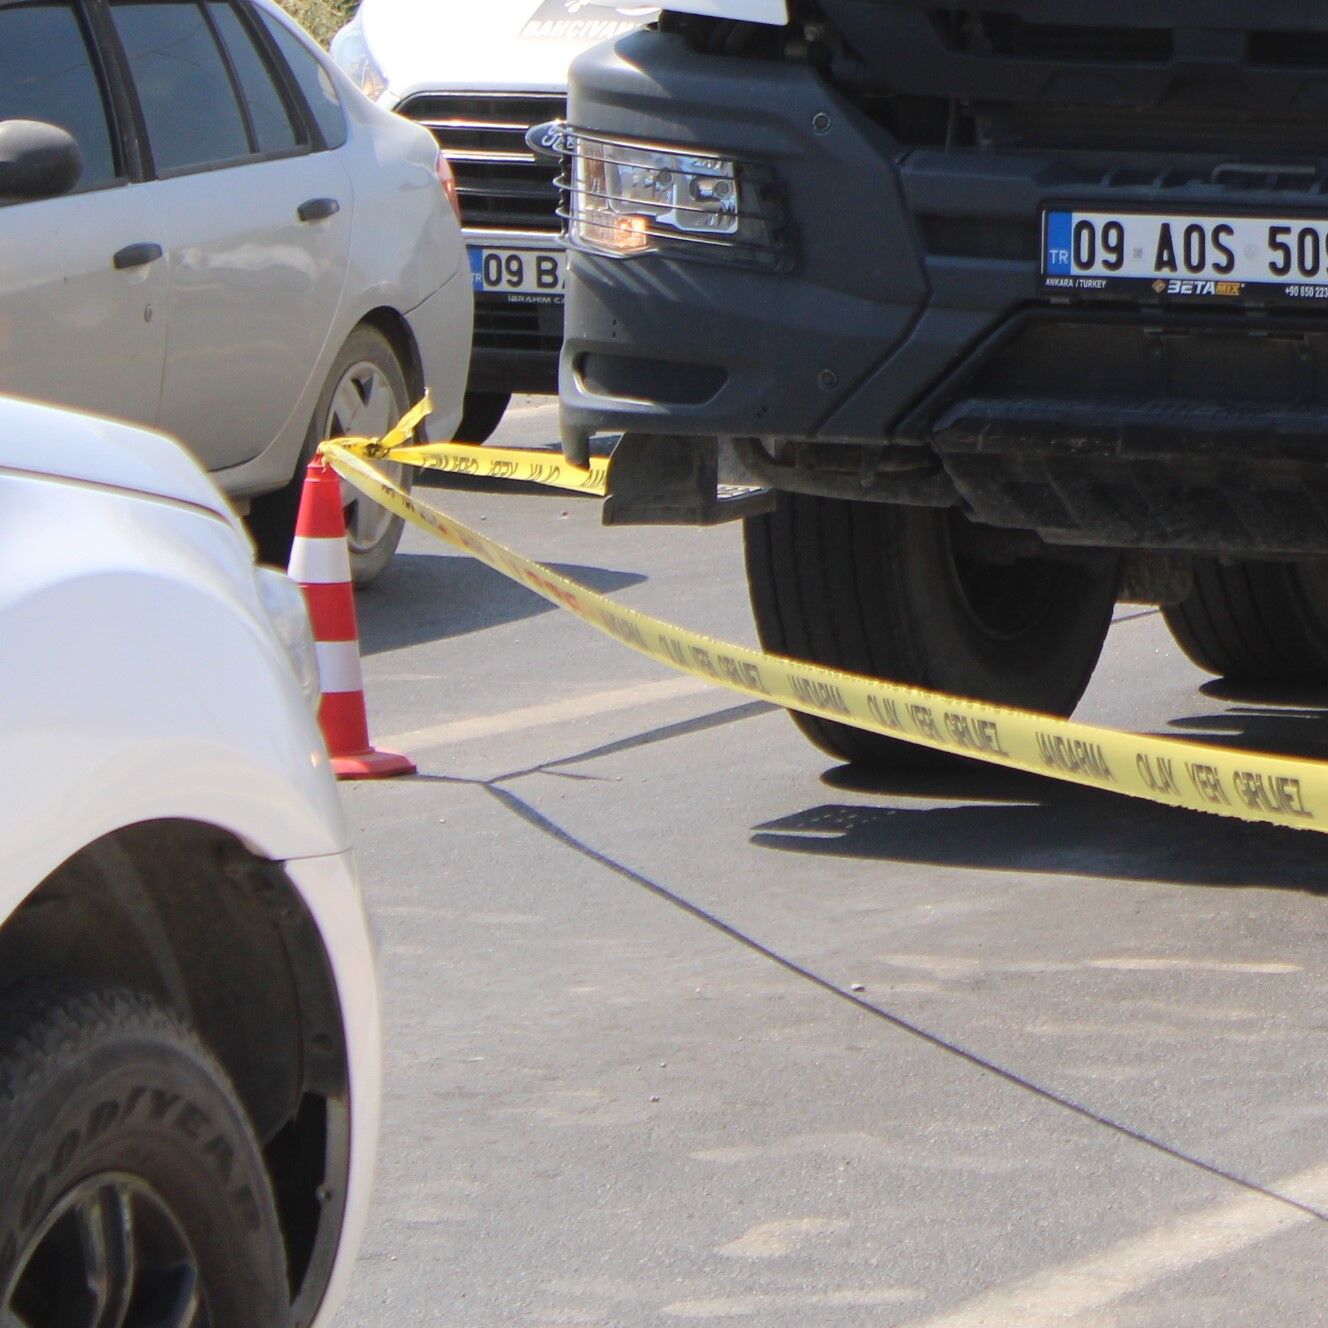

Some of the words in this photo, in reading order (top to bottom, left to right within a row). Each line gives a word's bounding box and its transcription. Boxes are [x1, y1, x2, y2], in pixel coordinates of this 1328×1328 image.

[1049, 249, 1068, 266] TR
[1072, 219, 1126, 273] 09
[1154, 222, 1236, 276] AOS
[483, 253, 524, 289] 09
[535, 255, 566, 290] B
[1045, 278, 1074, 288] ANKARA
[1284, 285, 1299, 297] +90
[1315, 286, 1328, 298] 223
[1034, 730, 1118, 783] JANDARMA
[1136, 752, 1182, 797] OLAY
